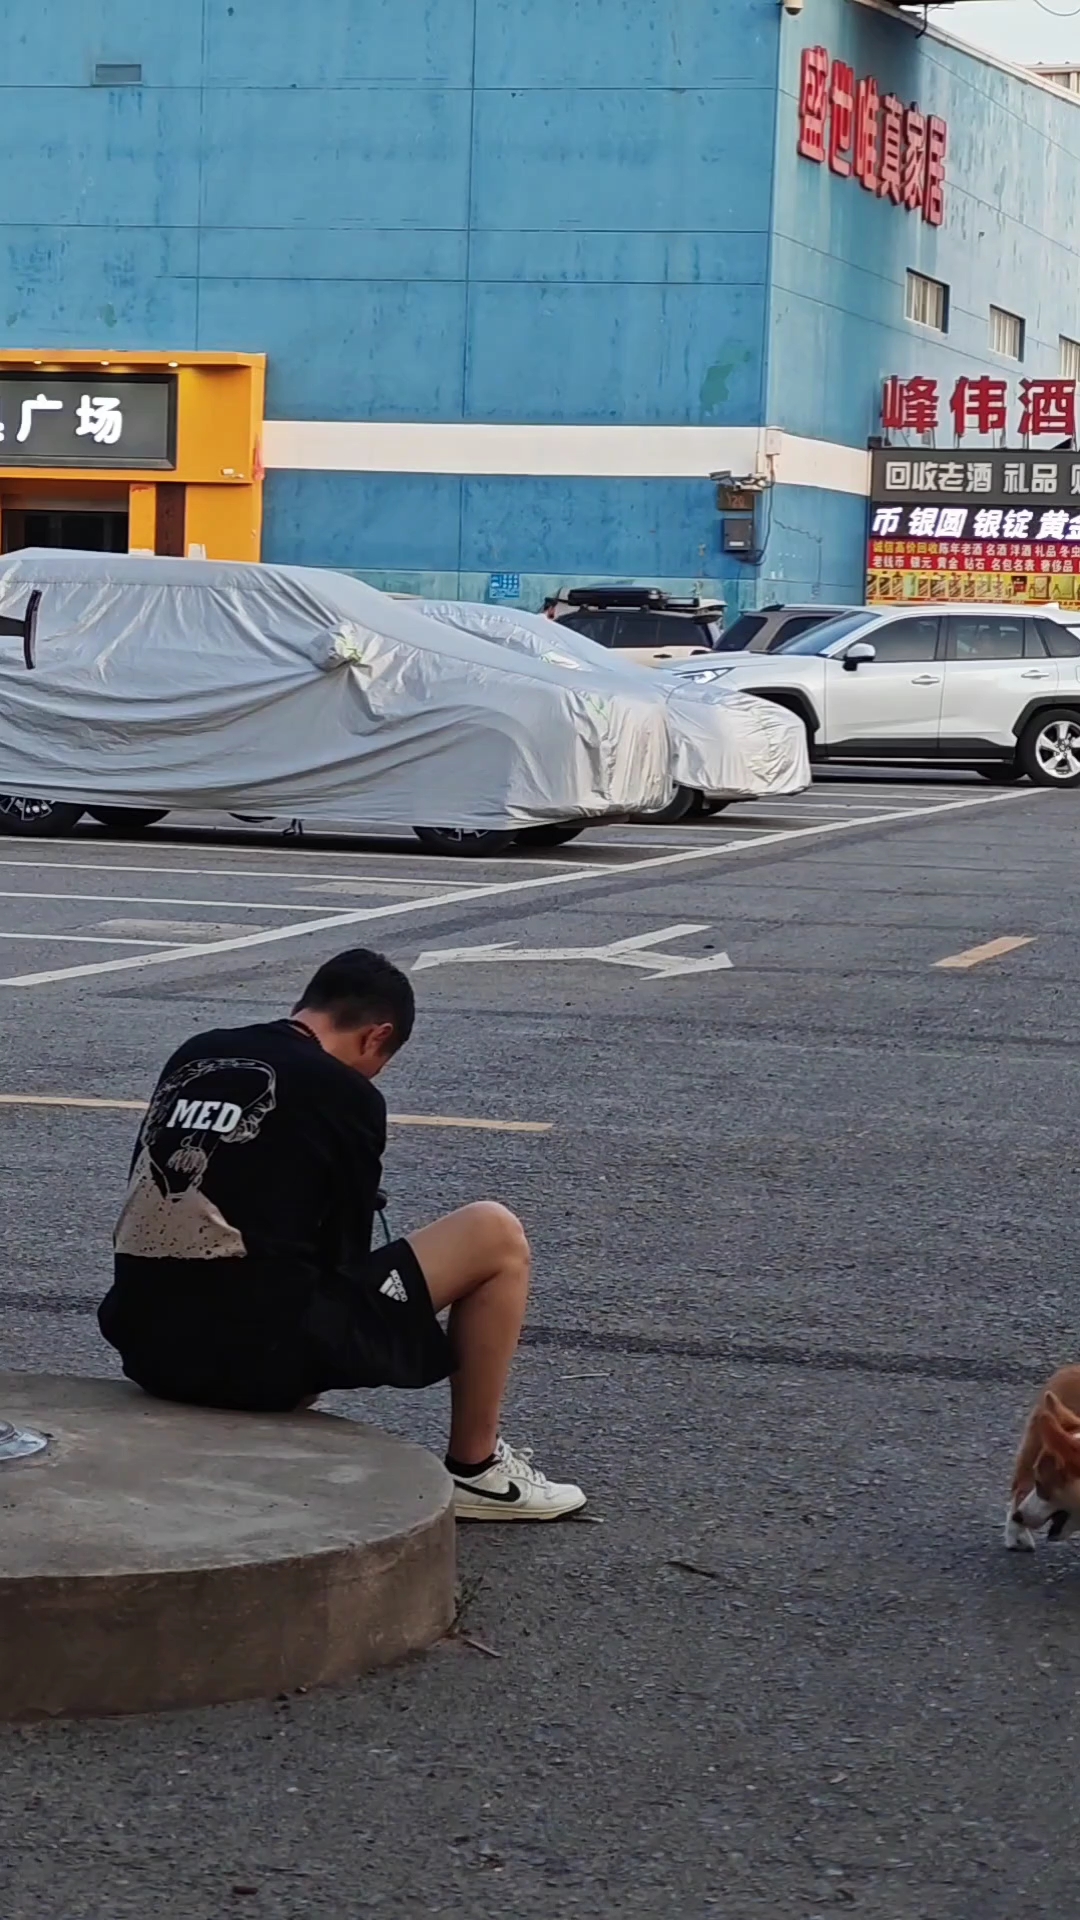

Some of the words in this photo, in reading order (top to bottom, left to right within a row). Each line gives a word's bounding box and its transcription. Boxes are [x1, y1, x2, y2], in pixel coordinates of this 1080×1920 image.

[0, 394, 122, 443] 广场
[881, 375, 1076, 435] 峰伟酒
[885, 461, 992, 492] 回收老酒
[1003, 463, 1057, 493] 礼品
[872, 507, 903, 536] 币
[908, 507, 968, 538] 银圆
[973, 509, 1033, 538] 银锭
[937, 557, 959, 569] 黄金
[991, 558, 1035, 571] 名包名表
[1041, 559, 1073, 572] 奢侈品
[986, 543, 1007, 556] 名酒
[1010, 544, 1032, 557] 洋酒
[1035, 544, 1057, 557] 礼品
[166, 1099, 242, 1133] MED
